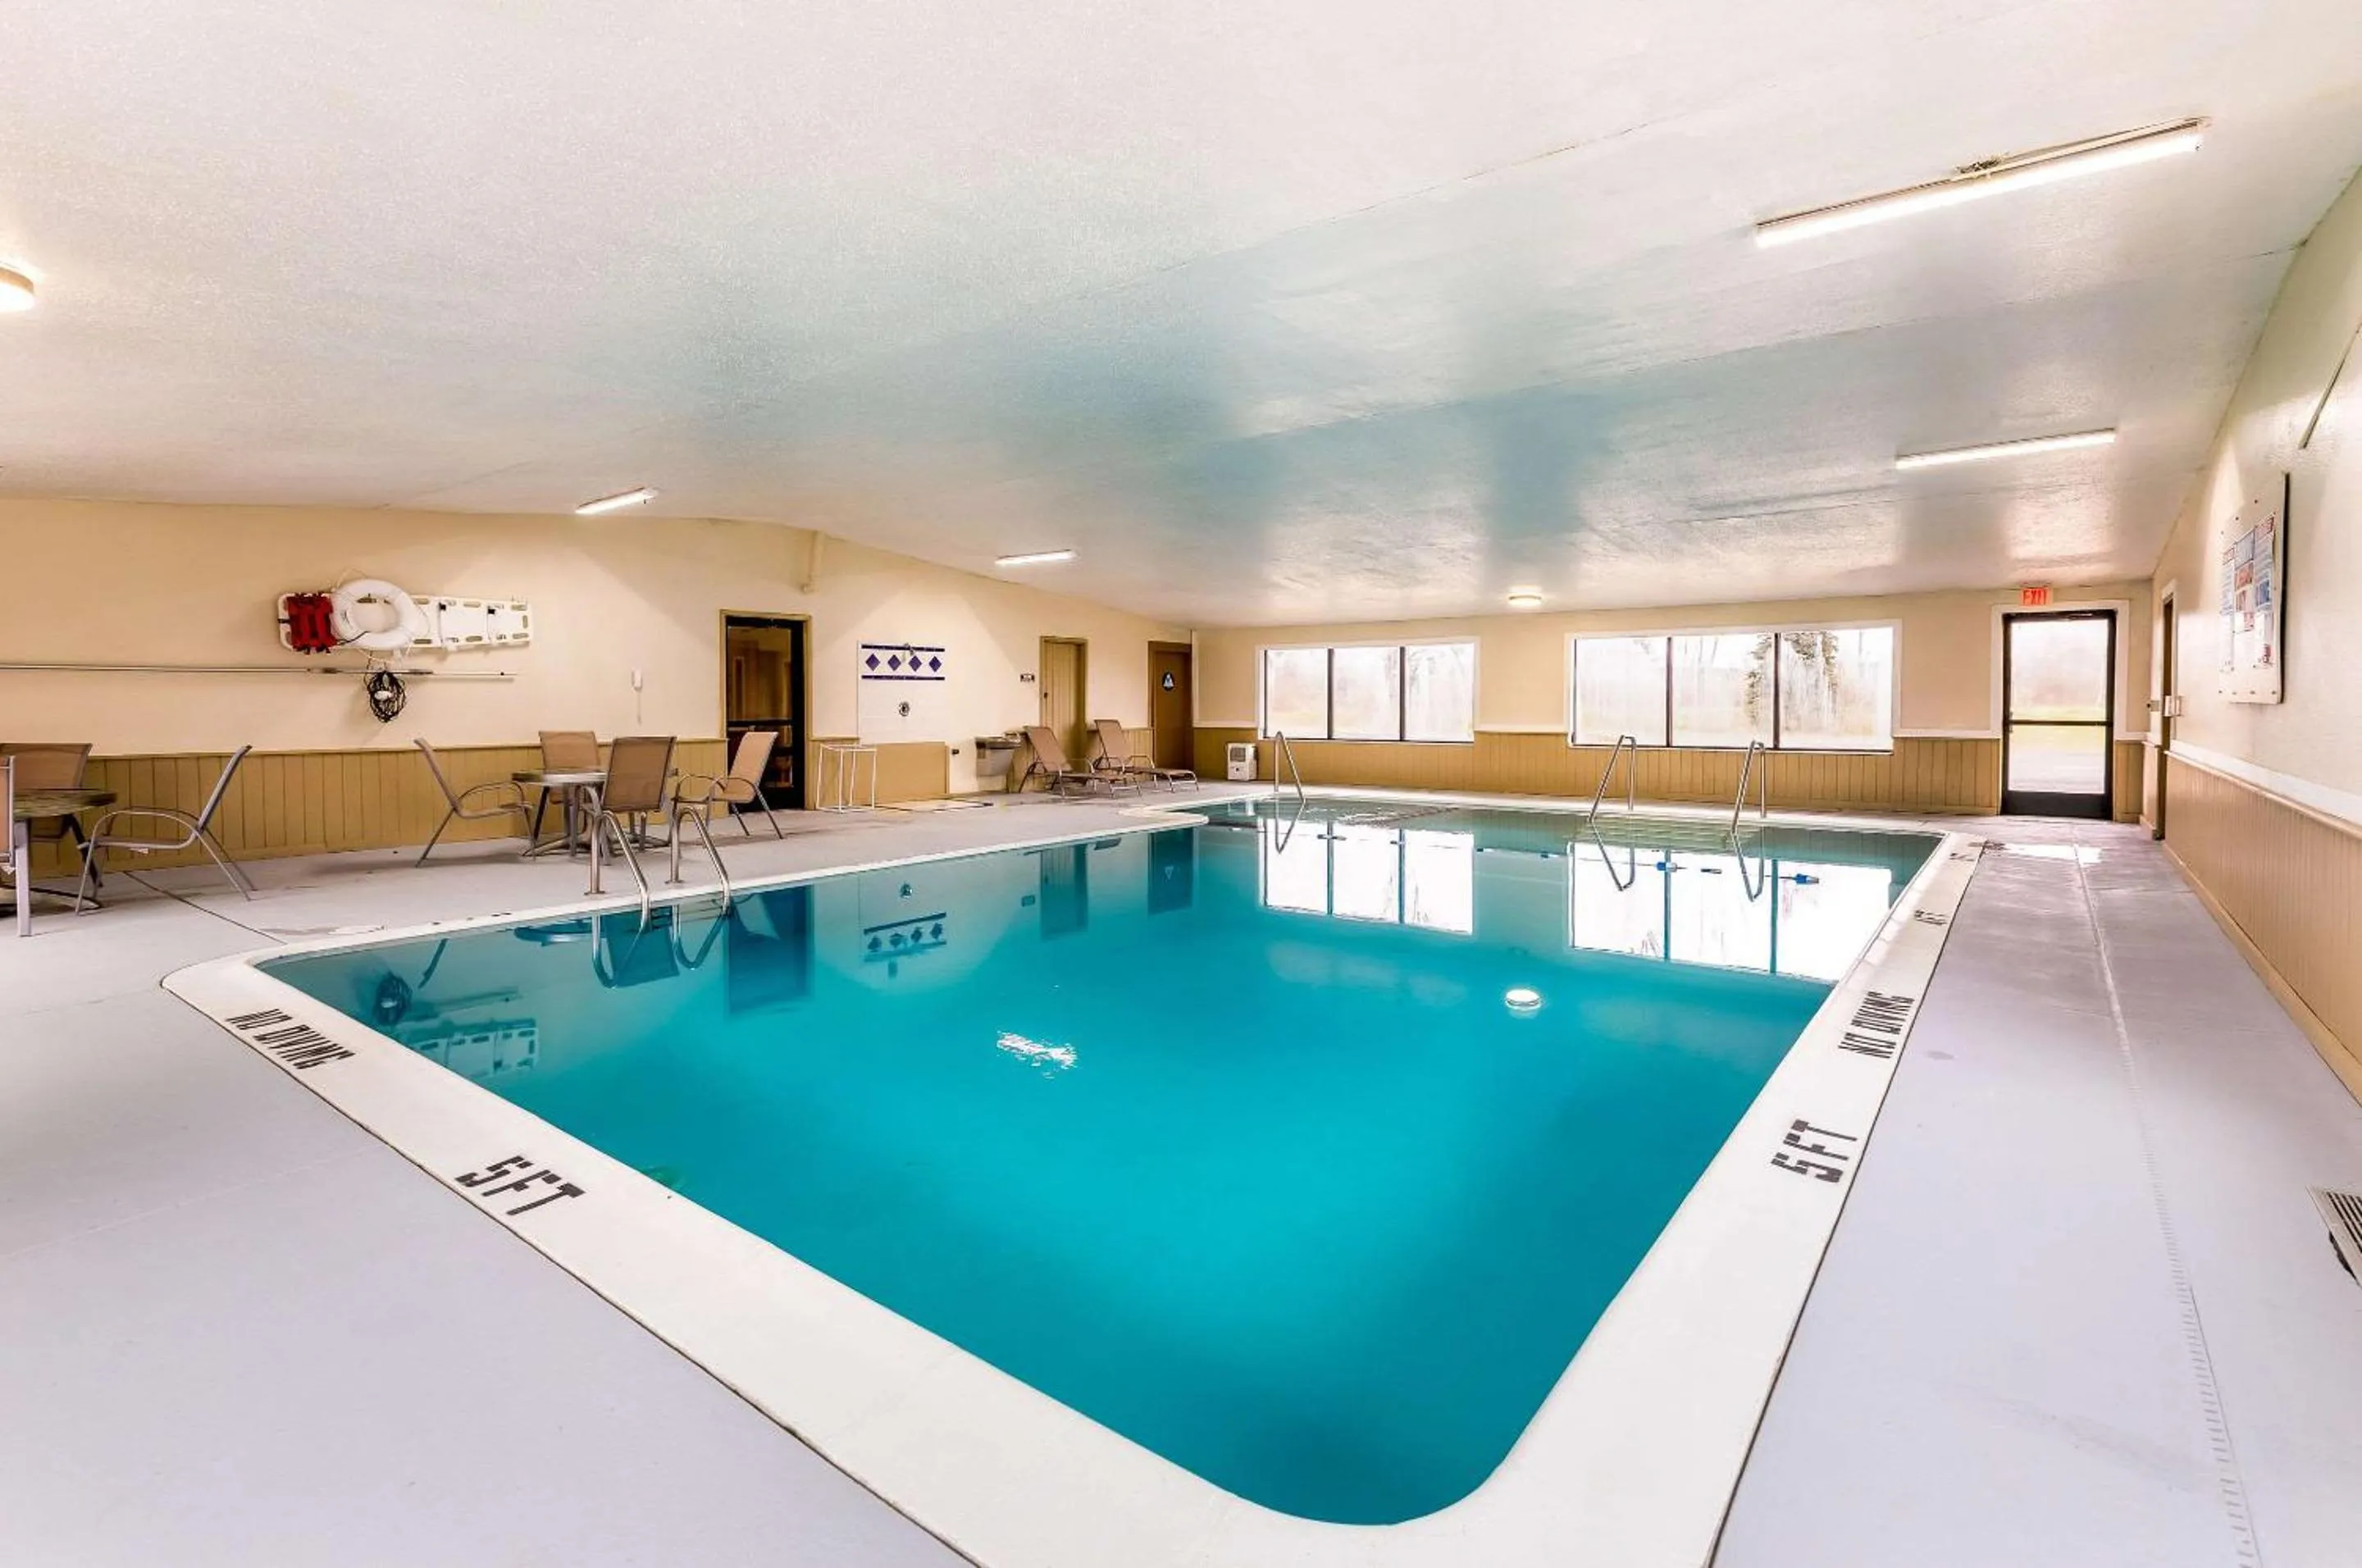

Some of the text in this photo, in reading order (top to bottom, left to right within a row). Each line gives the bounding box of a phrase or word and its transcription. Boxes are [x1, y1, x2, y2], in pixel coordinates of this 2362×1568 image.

[2022, 589, 2048, 605] EXIT
[226, 1008, 356, 1069] NO DIVING
[1838, 991, 1915, 1059] NO DIVING
